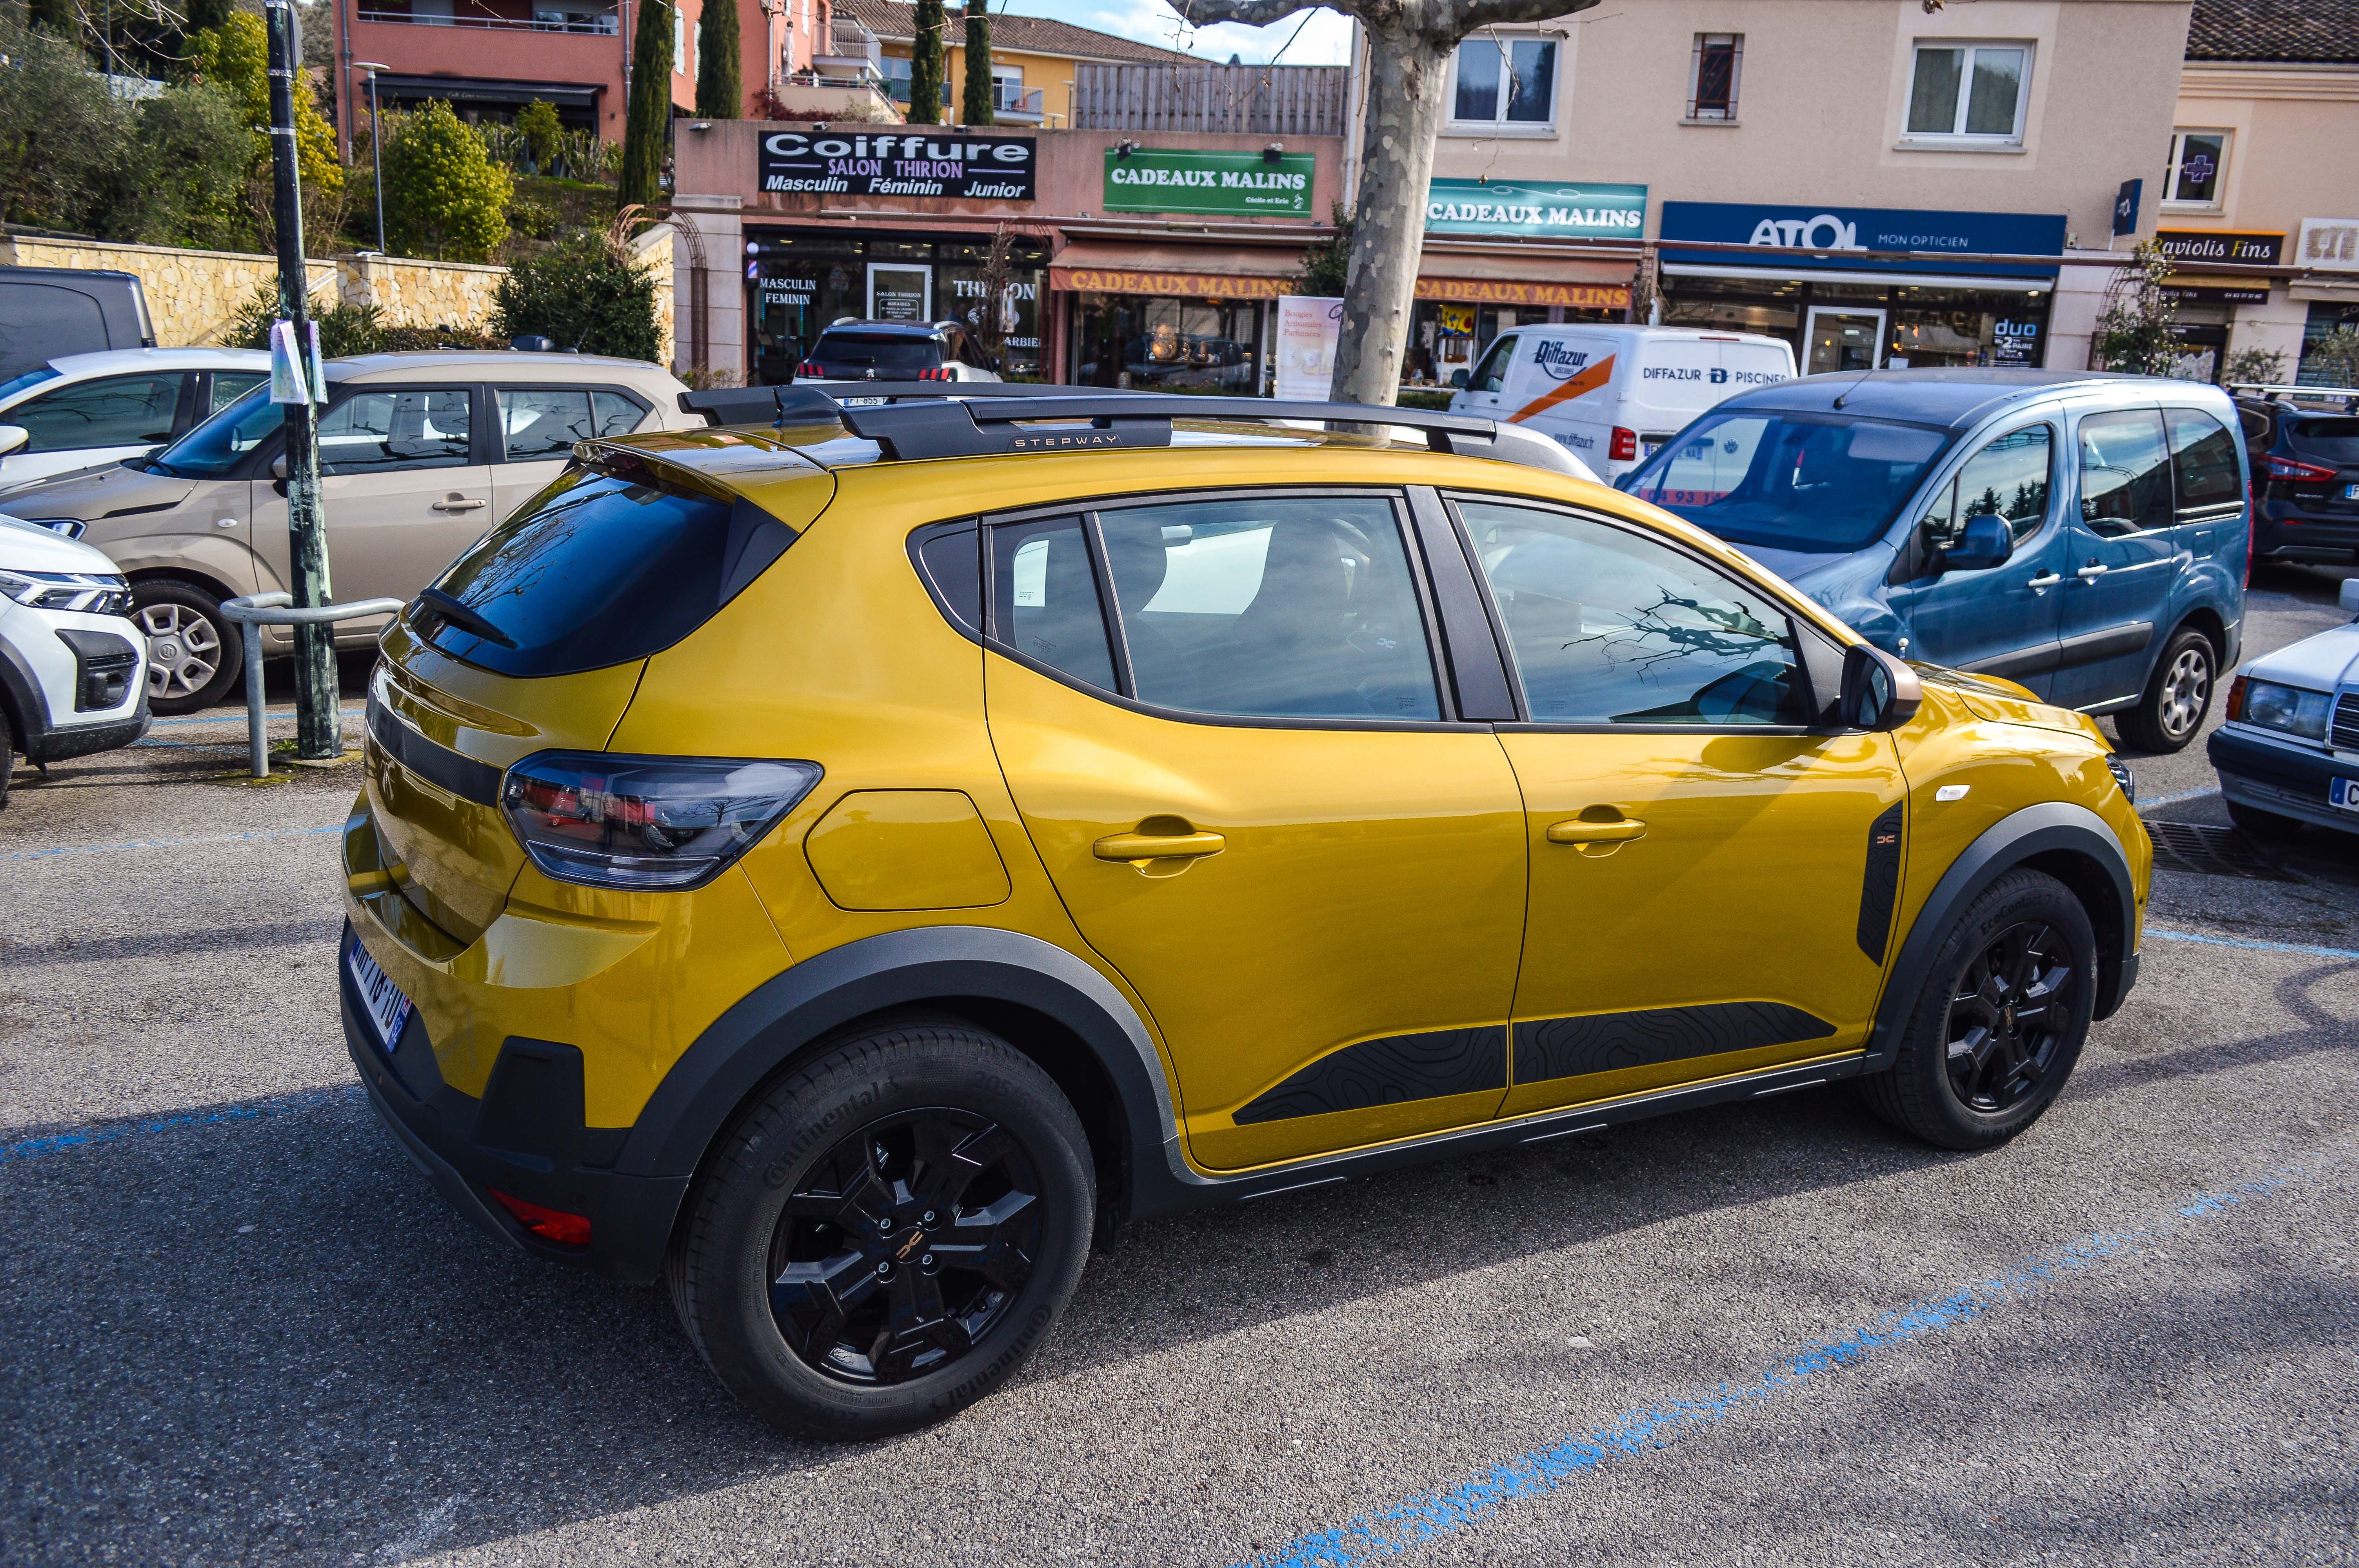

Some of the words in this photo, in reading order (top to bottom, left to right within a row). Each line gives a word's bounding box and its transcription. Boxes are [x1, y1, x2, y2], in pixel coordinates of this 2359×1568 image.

[765, 134, 1029, 162] Coiffure
[828, 158, 882, 176] SALON
[894, 160, 962, 178] THIRION
[766, 175, 848, 192] Masculin
[868, 178, 943, 195] Féminin
[963, 181, 1025, 198] Junior
[1111, 168, 1216, 187] CADEAUX
[1221, 171, 1306, 190] MALINS
[1427, 202, 1543, 225] CADEAUX
[1547, 207, 1641, 229] MALINS
[1749, 214, 1868, 260] ATOL
[1878, 234, 1908, 245] MON
[1910, 235, 1968, 248] OPTICIEN
[2232, 240, 2270, 258] Fins
[760, 278, 816, 290] MASCULIN
[953, 280, 1036, 300] THION
[1070, 270, 1192, 294] CADEAUX
[1197, 277, 1294, 298] MALINS
[1415, 280, 1529, 301] CADEAUX
[1535, 285, 1628, 306] MALINS
[765, 293, 810, 305] FEMININ
[1284, 309, 1312, 318] Bougies
[1995, 318, 2037, 336] duo
[1534, 340, 1588, 366] Diffazur
[1644, 367, 1701, 380] DIFFAZUR
[1736, 371, 1787, 384] PISCINES
[1015, 436, 1117, 447] STEPWAY
[763, 1081, 881, 1190] Continental
[948, 1304, 1052, 1407] Continental
